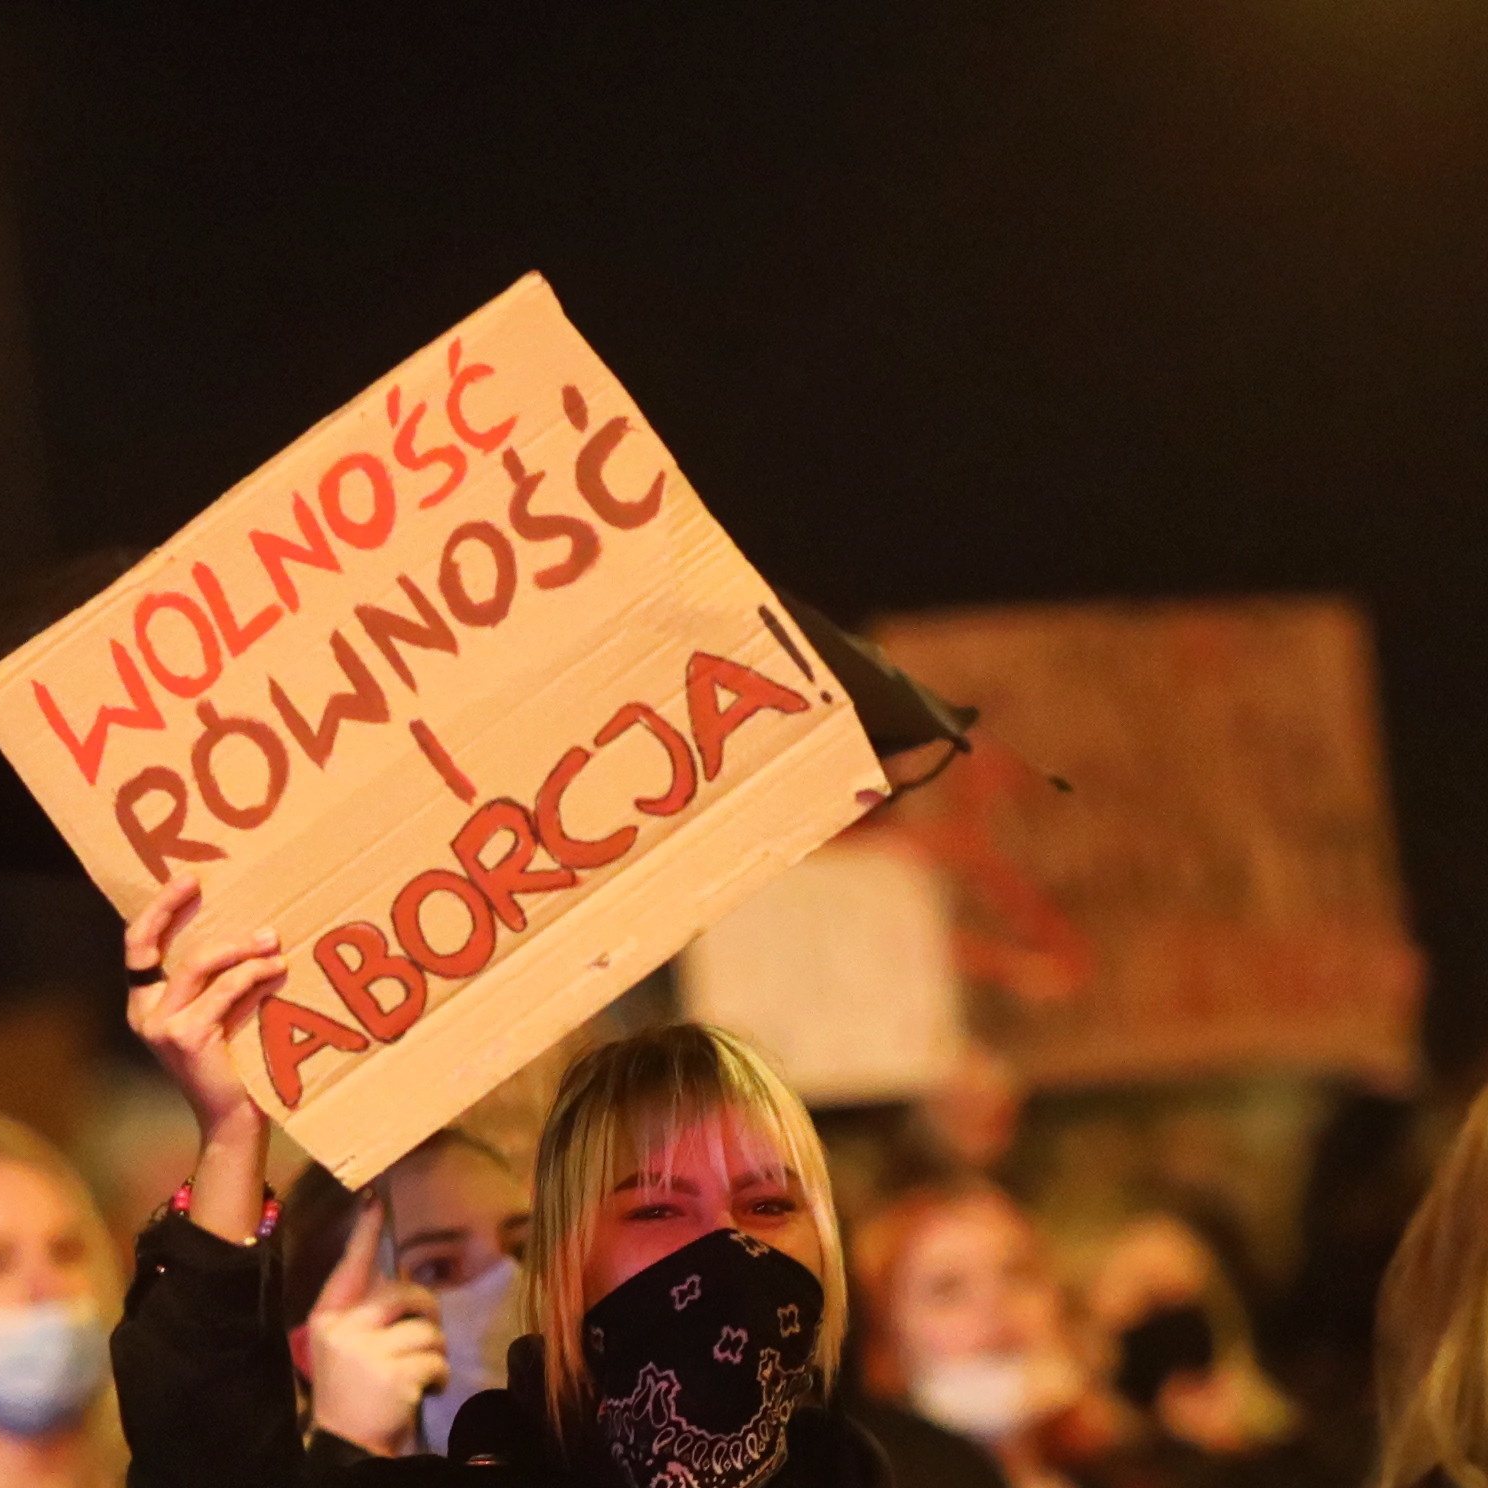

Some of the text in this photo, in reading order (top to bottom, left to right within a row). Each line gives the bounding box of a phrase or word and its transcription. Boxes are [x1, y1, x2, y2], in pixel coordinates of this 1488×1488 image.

[31, 337, 518, 785] WOLNOŚĆ
[113, 384, 666, 883] RÓWNOŚĆ
[410, 719, 476, 805] I
[257, 603, 837, 1110] ABORCJA!
